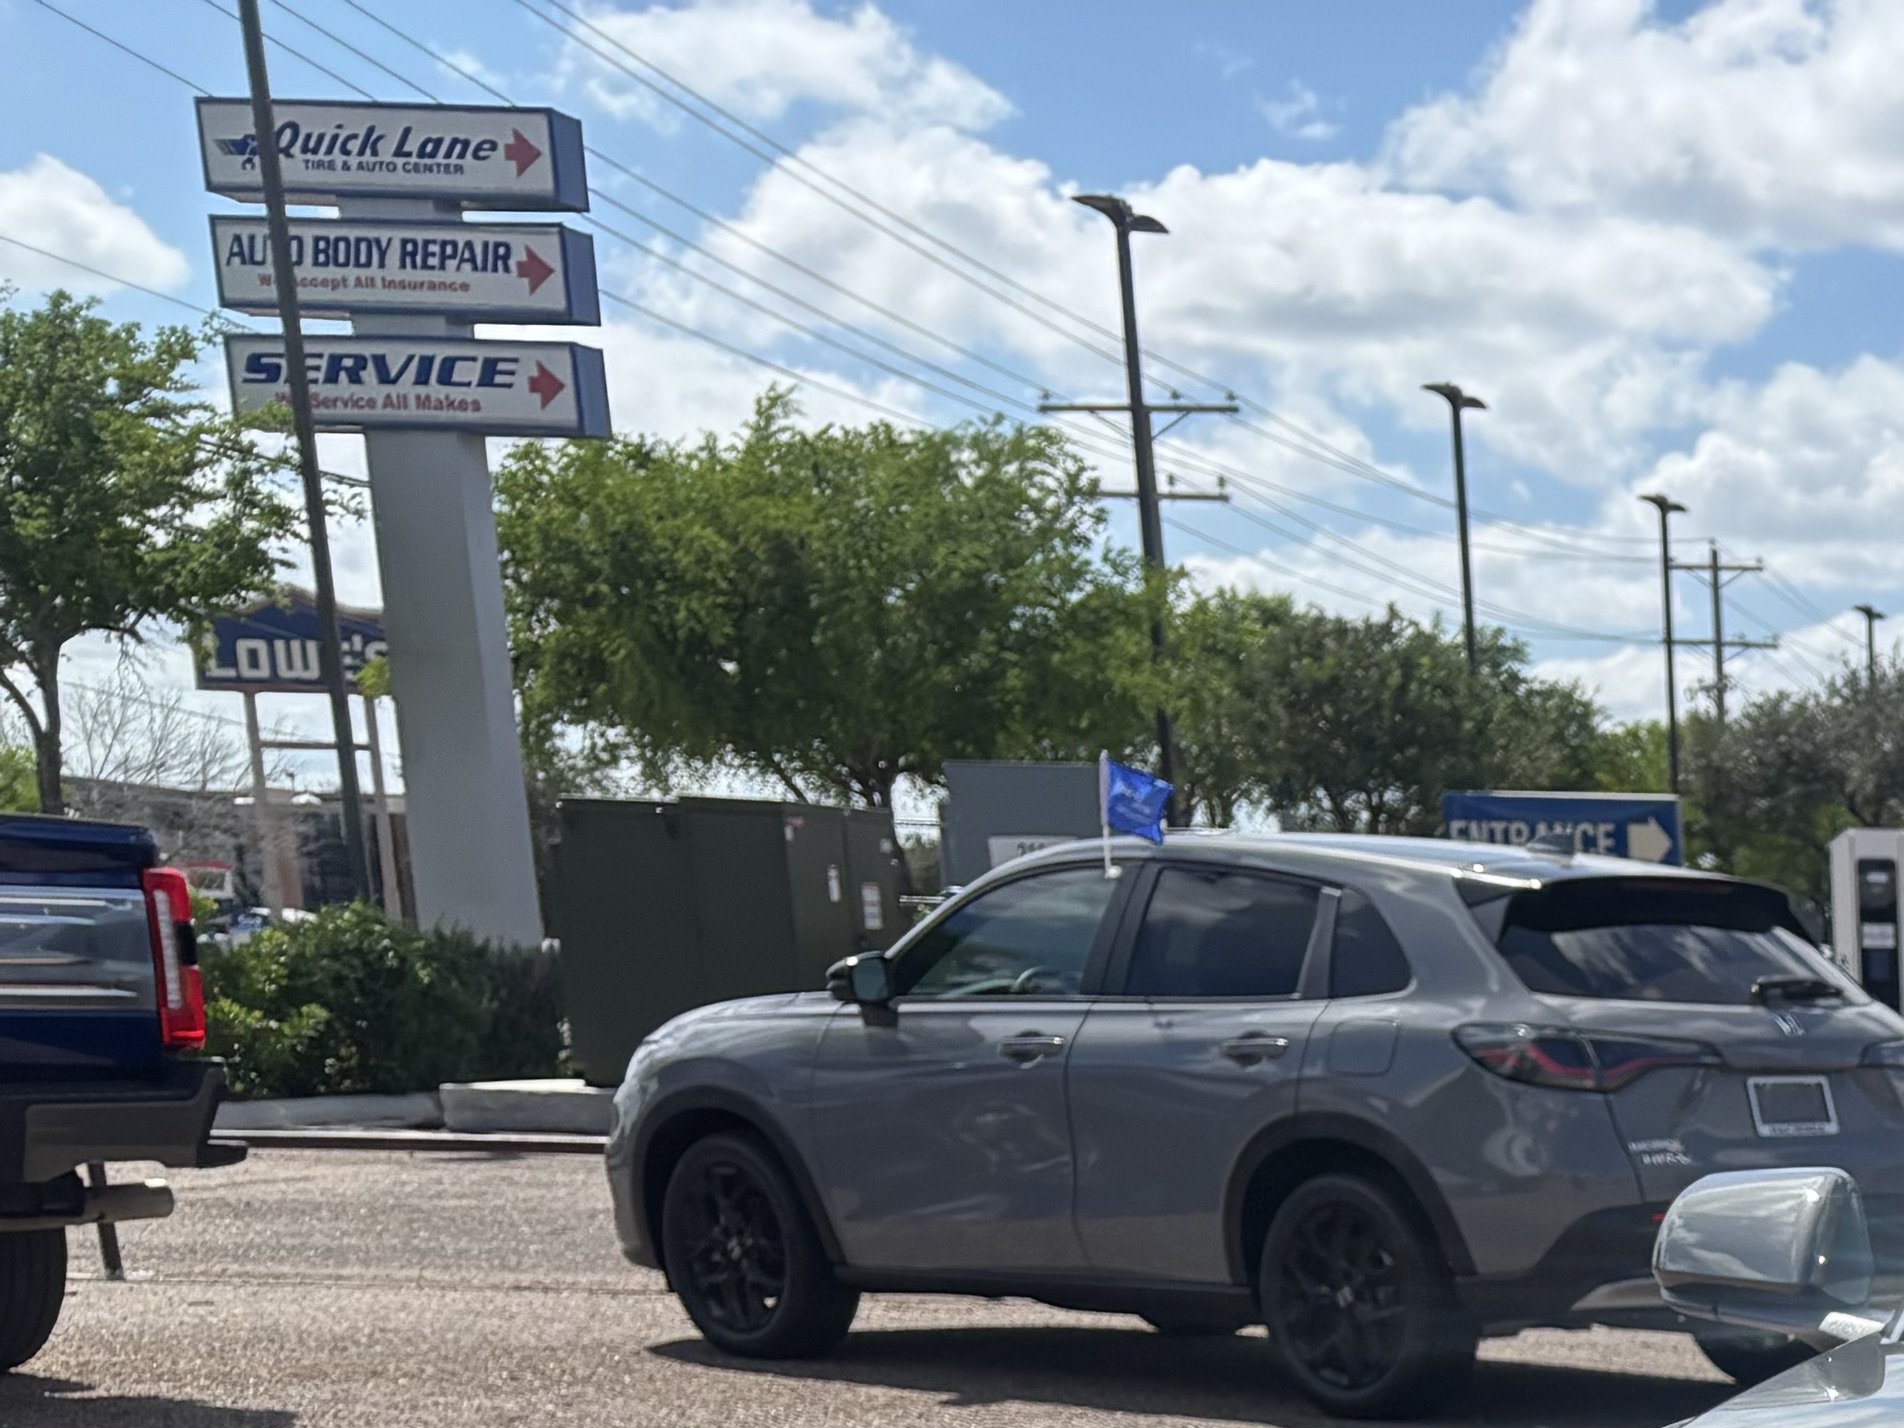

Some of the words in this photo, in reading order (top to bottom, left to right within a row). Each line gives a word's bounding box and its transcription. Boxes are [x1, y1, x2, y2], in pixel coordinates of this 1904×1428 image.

[274, 120, 386, 159] Quick
[391, 125, 498, 161] Lane
[303, 158, 336, 172] TIRE
[341, 160, 352, 172] &
[355, 160, 398, 173] AUTO
[401, 161, 465, 176] CENTER
[225, 233, 304, 268] AUO
[311, 234, 392, 269] BODY
[399, 238, 513, 274] REPAIR
[295, 275, 348, 292] ccept
[353, 275, 376, 290] All
[380, 275, 471, 293] Insurance
[242, 352, 519, 389] SERVICE
[382, 392, 409, 411] All
[414, 393, 482, 413] Makes
